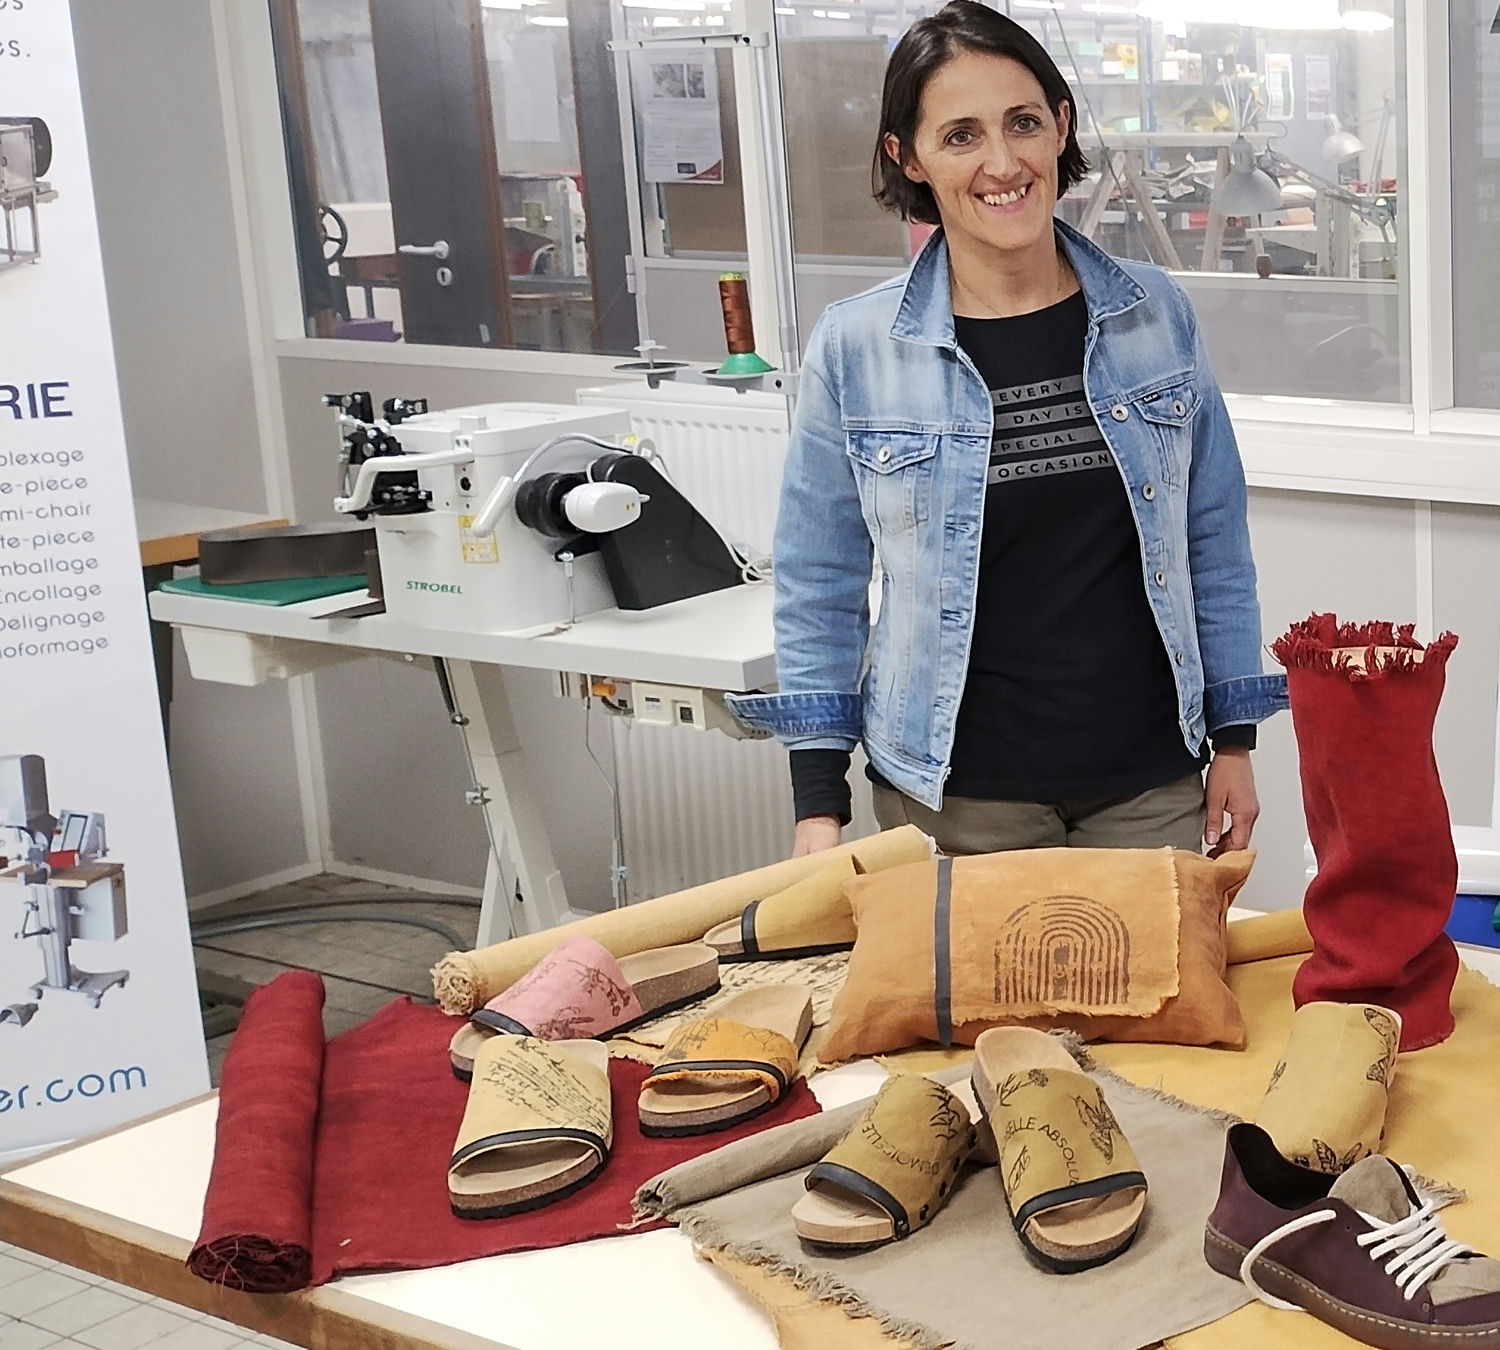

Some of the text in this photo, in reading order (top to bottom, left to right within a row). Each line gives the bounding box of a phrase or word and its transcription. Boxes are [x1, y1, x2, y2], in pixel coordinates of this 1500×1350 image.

[1000, 382, 1062, 402] EVERY
[1014, 405, 1083, 424] DAY IS
[991, 433, 1077, 452] PECIAL
[998, 454, 1110, 478] OCCASION
[0, 502, 91, 521] mi-chair
[0, 584, 102, 604] ncollage
[406, 580, 463, 595] STROBEL
[0, 637, 108, 659] oformage
